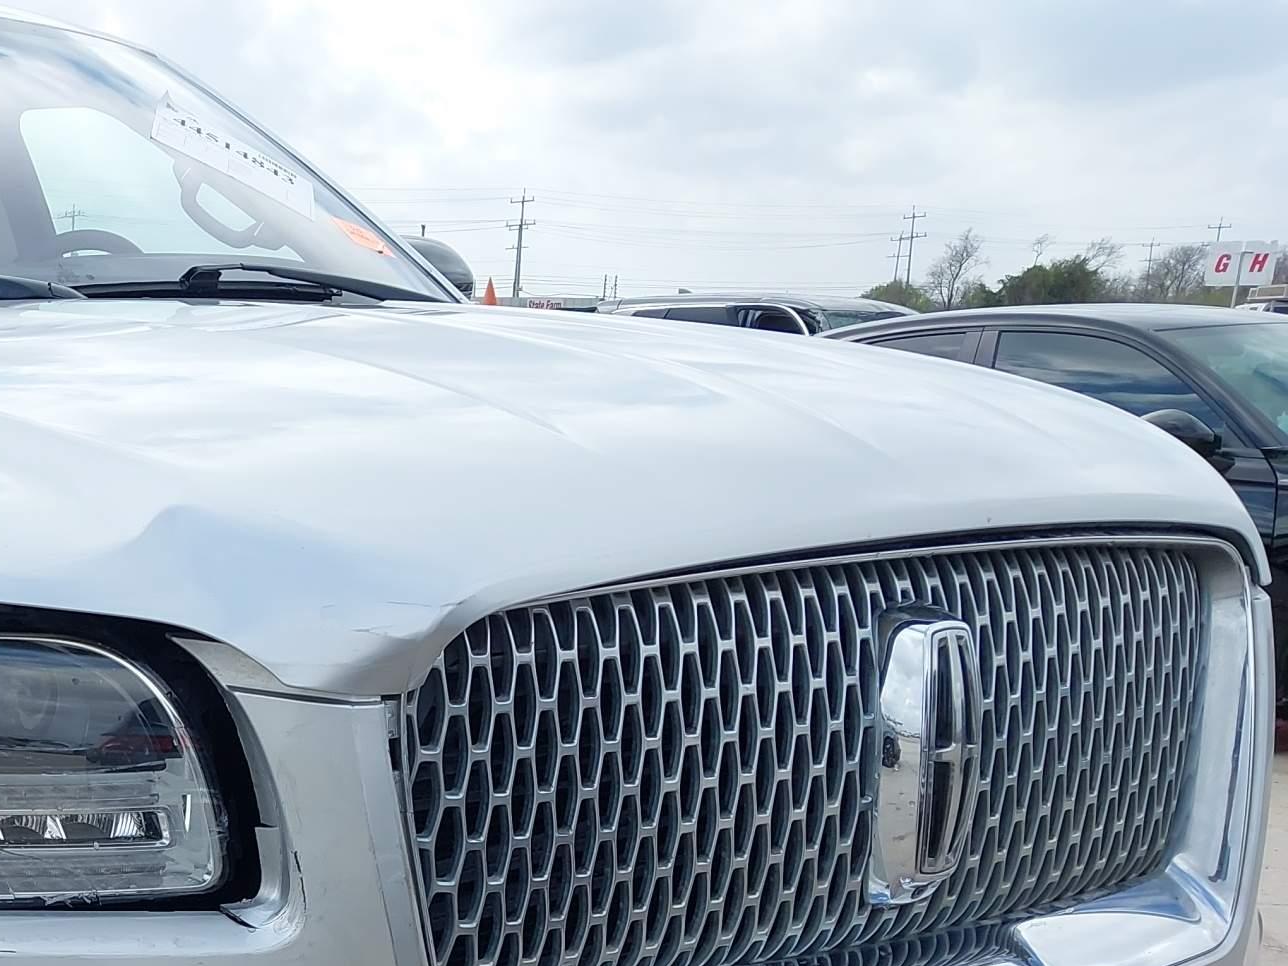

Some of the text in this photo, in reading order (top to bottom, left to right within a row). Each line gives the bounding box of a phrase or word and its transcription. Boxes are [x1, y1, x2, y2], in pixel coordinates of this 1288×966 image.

[1214, 253, 1269, 273] G H
[546, 300, 562, 310] Farm
